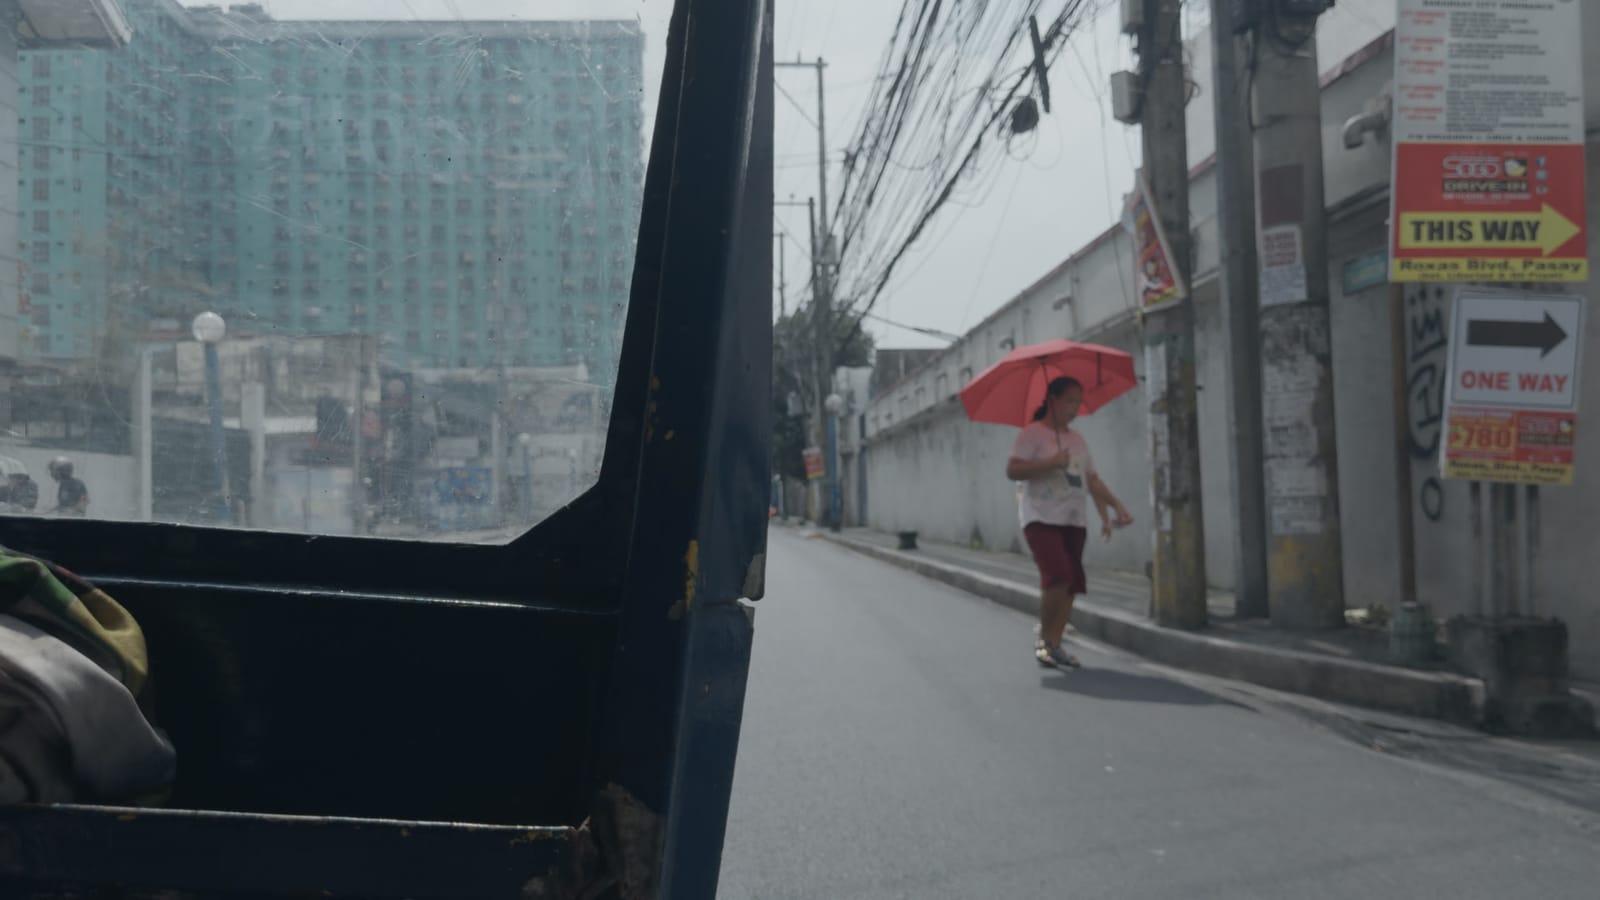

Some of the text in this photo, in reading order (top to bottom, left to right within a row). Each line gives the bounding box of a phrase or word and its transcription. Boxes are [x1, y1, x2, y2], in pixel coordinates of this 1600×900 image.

[1443, 180, 1528, 191] DRIVE-IN
[1410, 220, 1541, 241] THIS WAY
[1522, 260, 1582, 272] Pasay
[1460, 370, 1568, 392] ONE WAY
